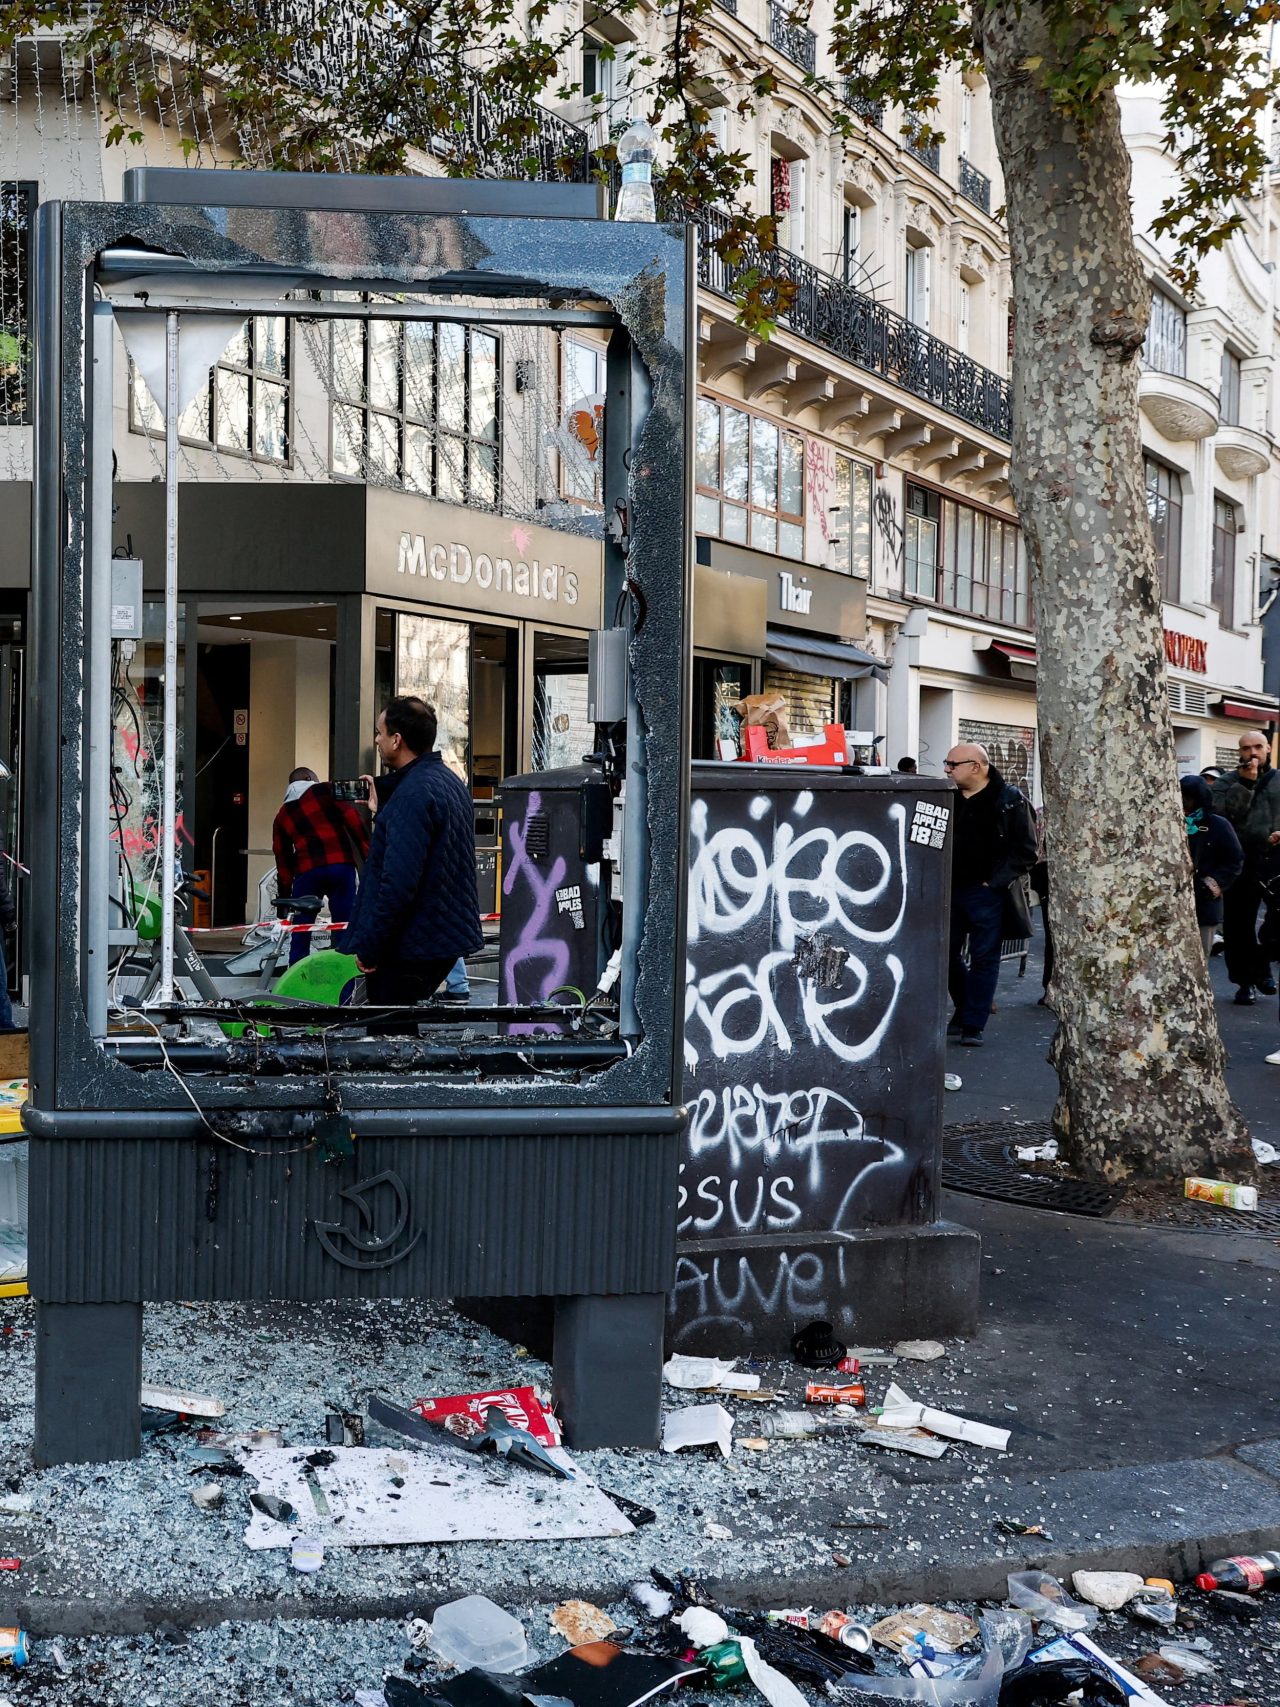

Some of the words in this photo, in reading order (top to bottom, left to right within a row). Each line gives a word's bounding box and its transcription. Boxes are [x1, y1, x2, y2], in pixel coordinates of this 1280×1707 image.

[397, 530, 579, 605] McDonald's
[915, 801, 950, 820] @BAD
[912, 812, 948, 832] APPLES
[910, 824, 931, 845] 18
[811, 1394, 860, 1406] PULSE
